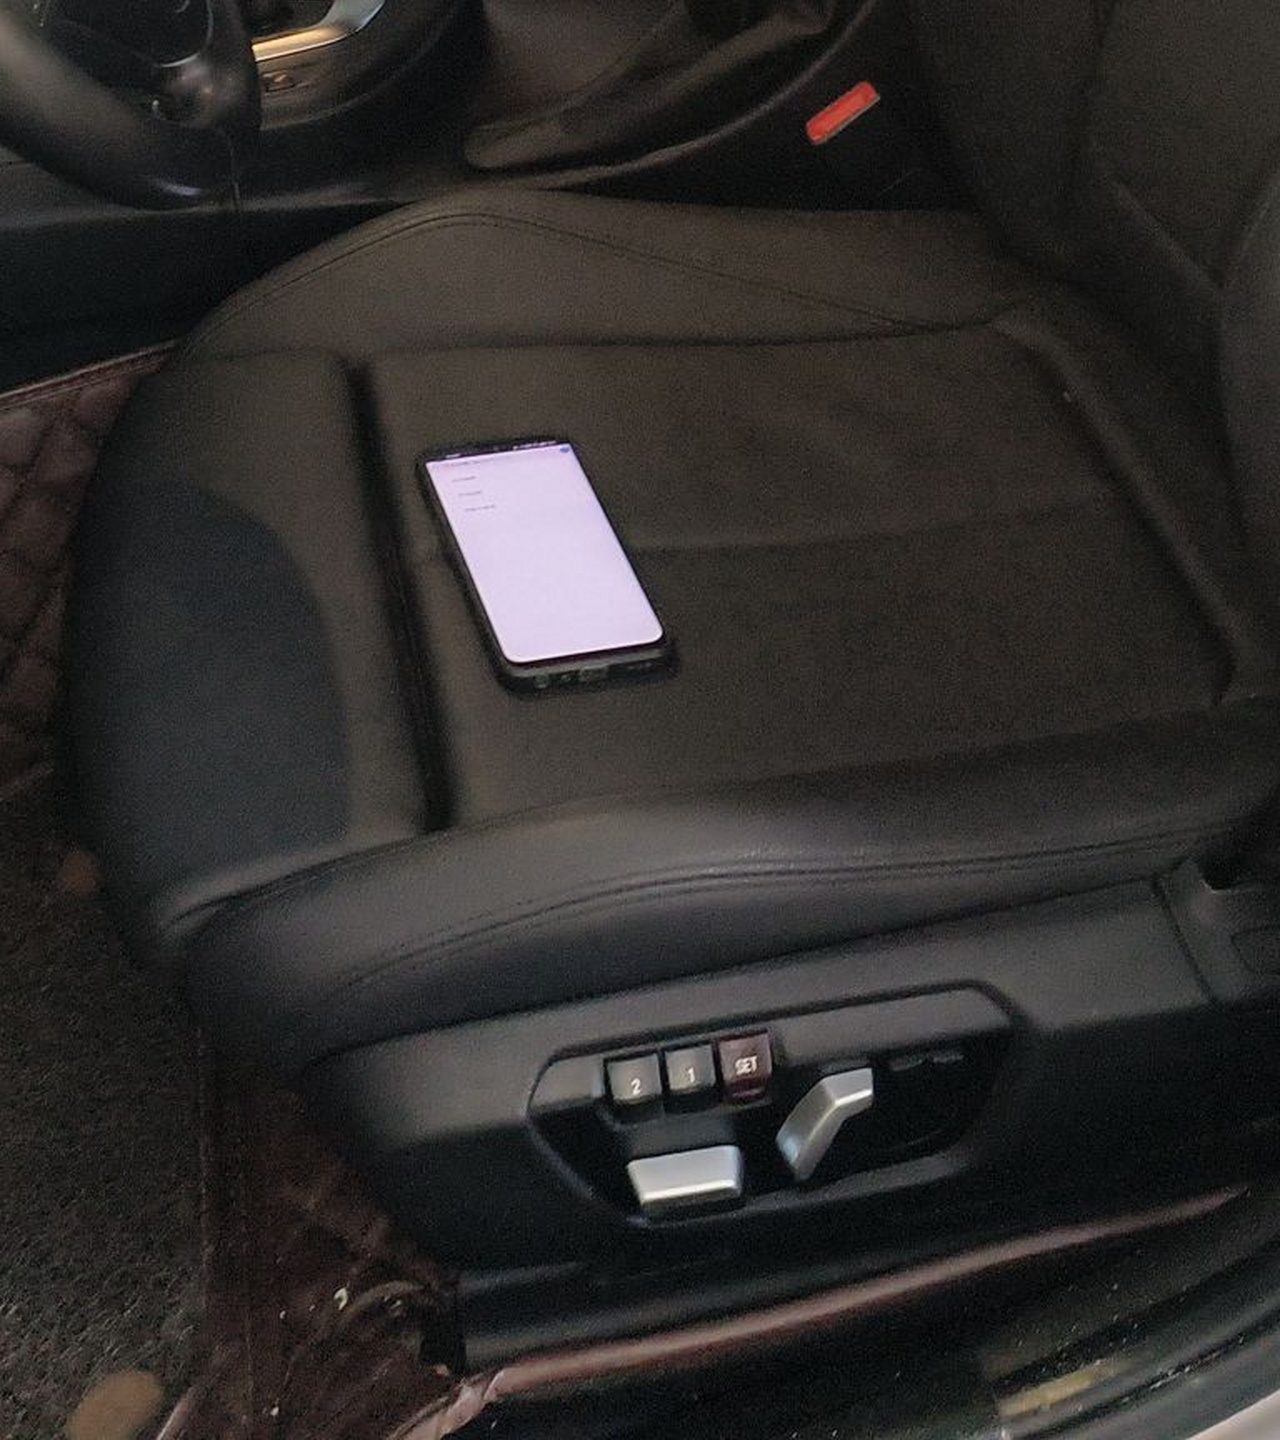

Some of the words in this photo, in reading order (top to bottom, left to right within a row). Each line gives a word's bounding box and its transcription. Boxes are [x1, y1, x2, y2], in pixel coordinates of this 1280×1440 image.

[630, 1078, 642, 1096] 2
[687, 1068, 695, 1083] 1
[735, 1056, 758, 1075] SET
